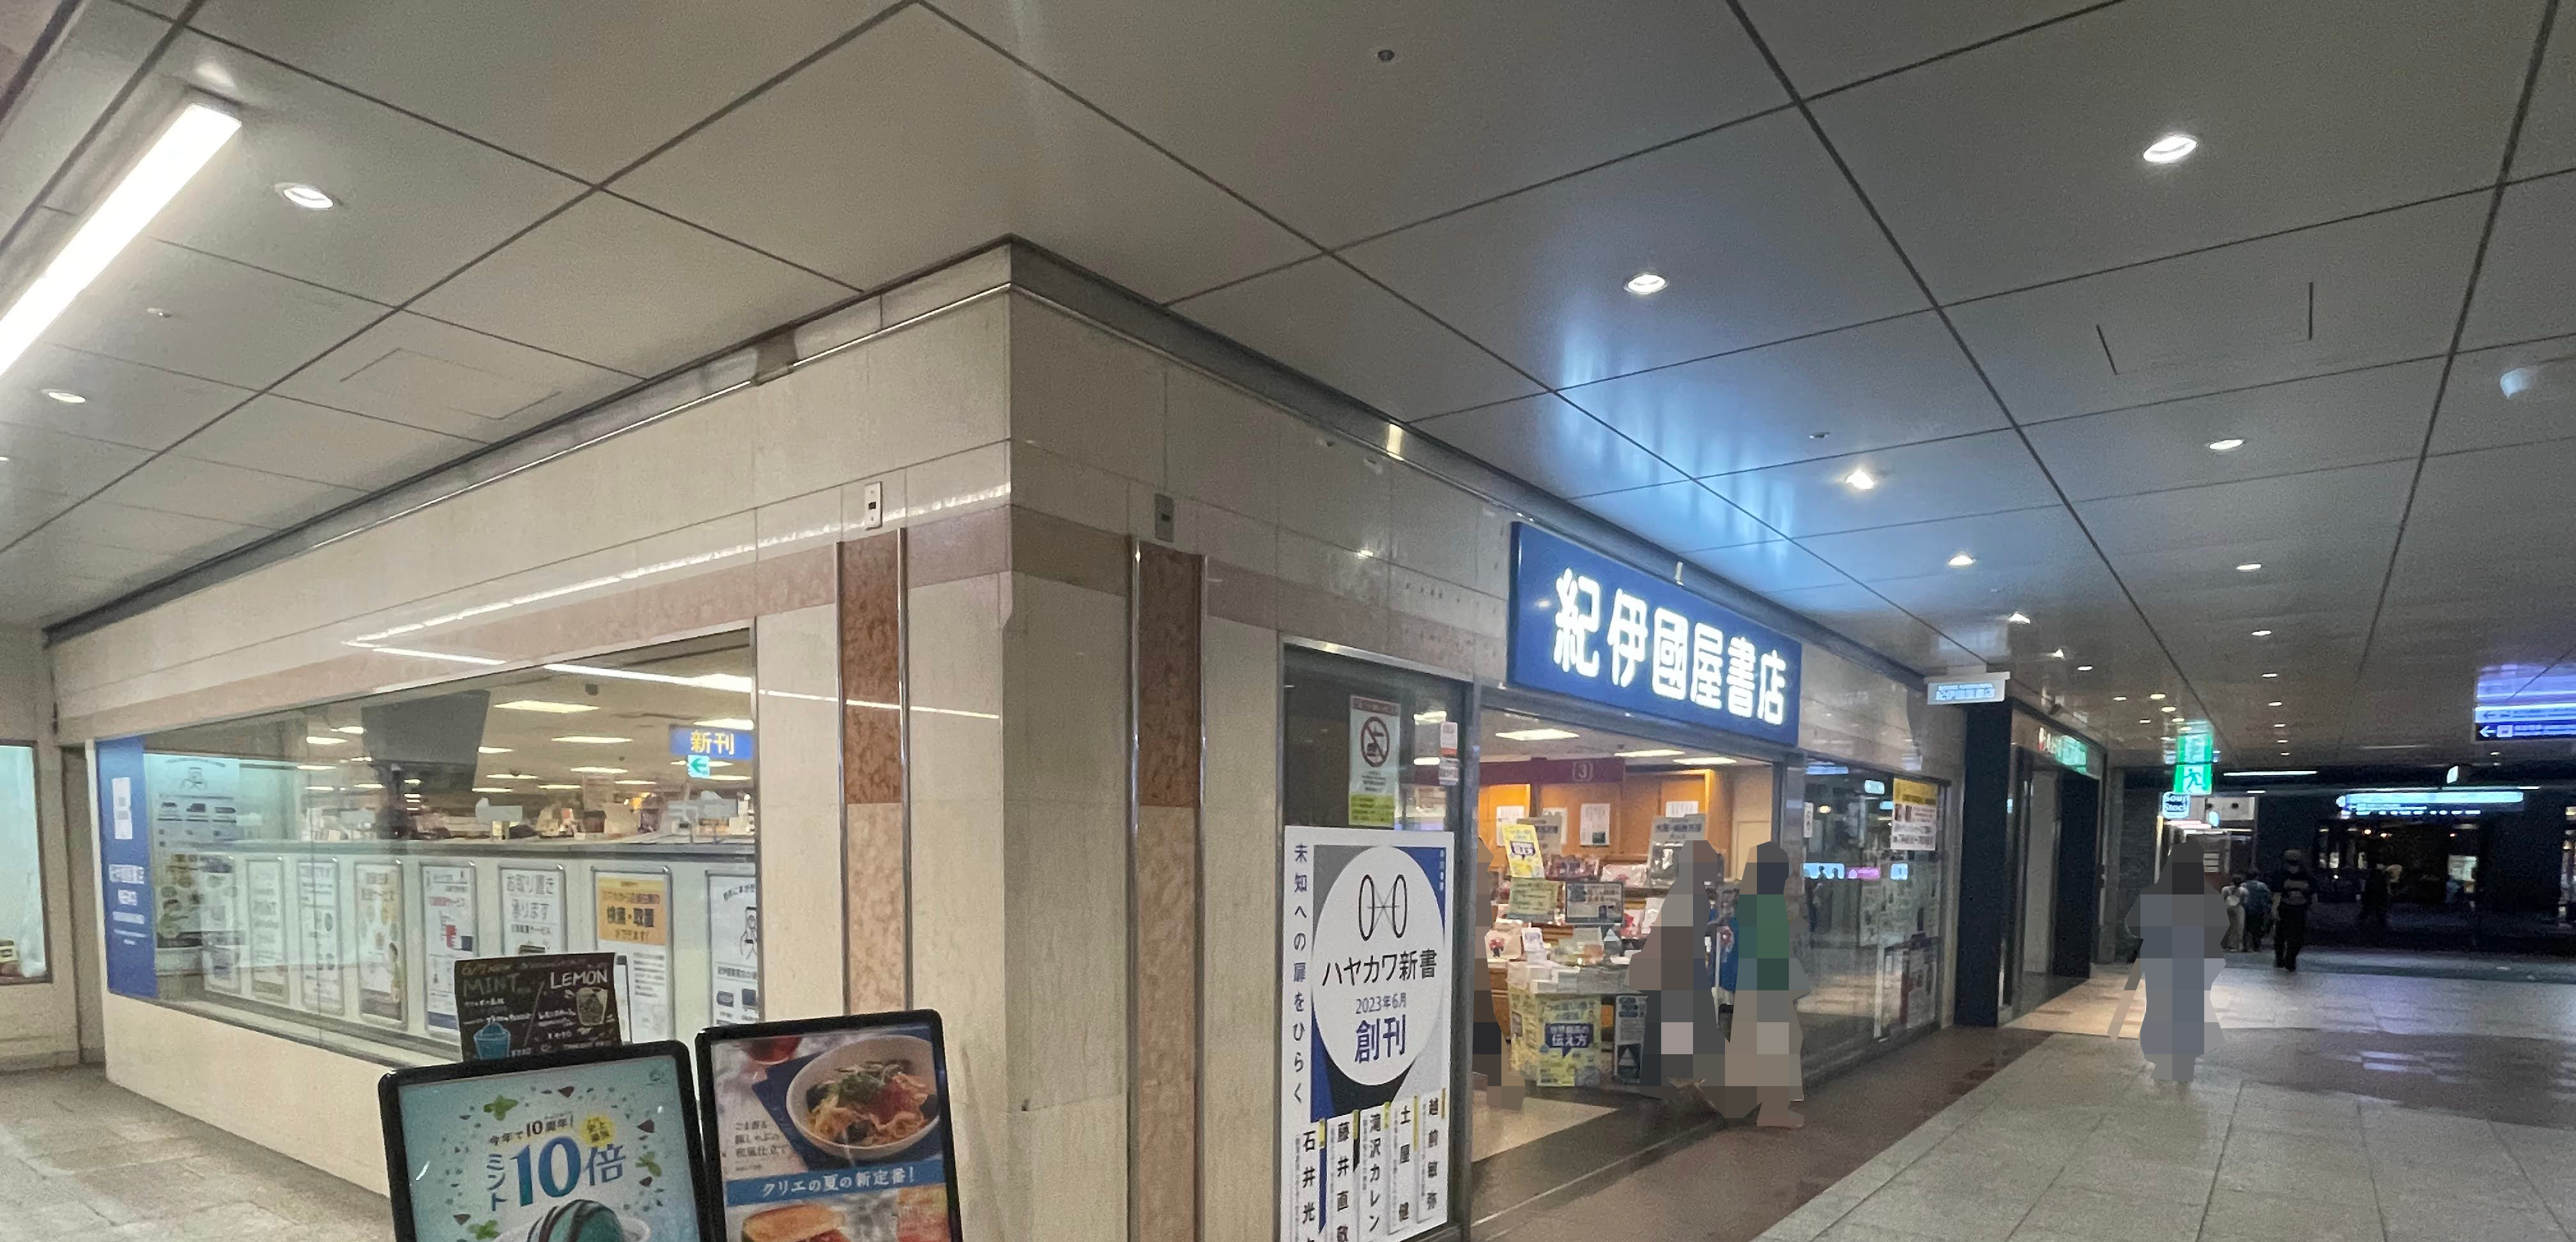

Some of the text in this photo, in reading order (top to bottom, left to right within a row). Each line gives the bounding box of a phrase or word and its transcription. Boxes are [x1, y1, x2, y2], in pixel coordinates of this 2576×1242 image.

[1554, 567, 1787, 726] 紀伊國屋書店
[689, 729, 736, 756] 新刊
[463, 972, 520, 997] MINT
[550, 968, 609, 990] LEMON
[1293, 844, 1308, 1105] 未知への扉をひらく
[1322, 948, 1438, 986] ハヤカワ新書
[1355, 992, 1407, 1015] 2023年6月
[1354, 1013, 1406, 1064] 創刊
[1552, 1033, 1588, 1046] 伝え方
[486, 1153, 508, 1212] ミント
[510, 1135, 627, 1207] 10倍
[1302, 1129, 1316, 1242] 石井光
